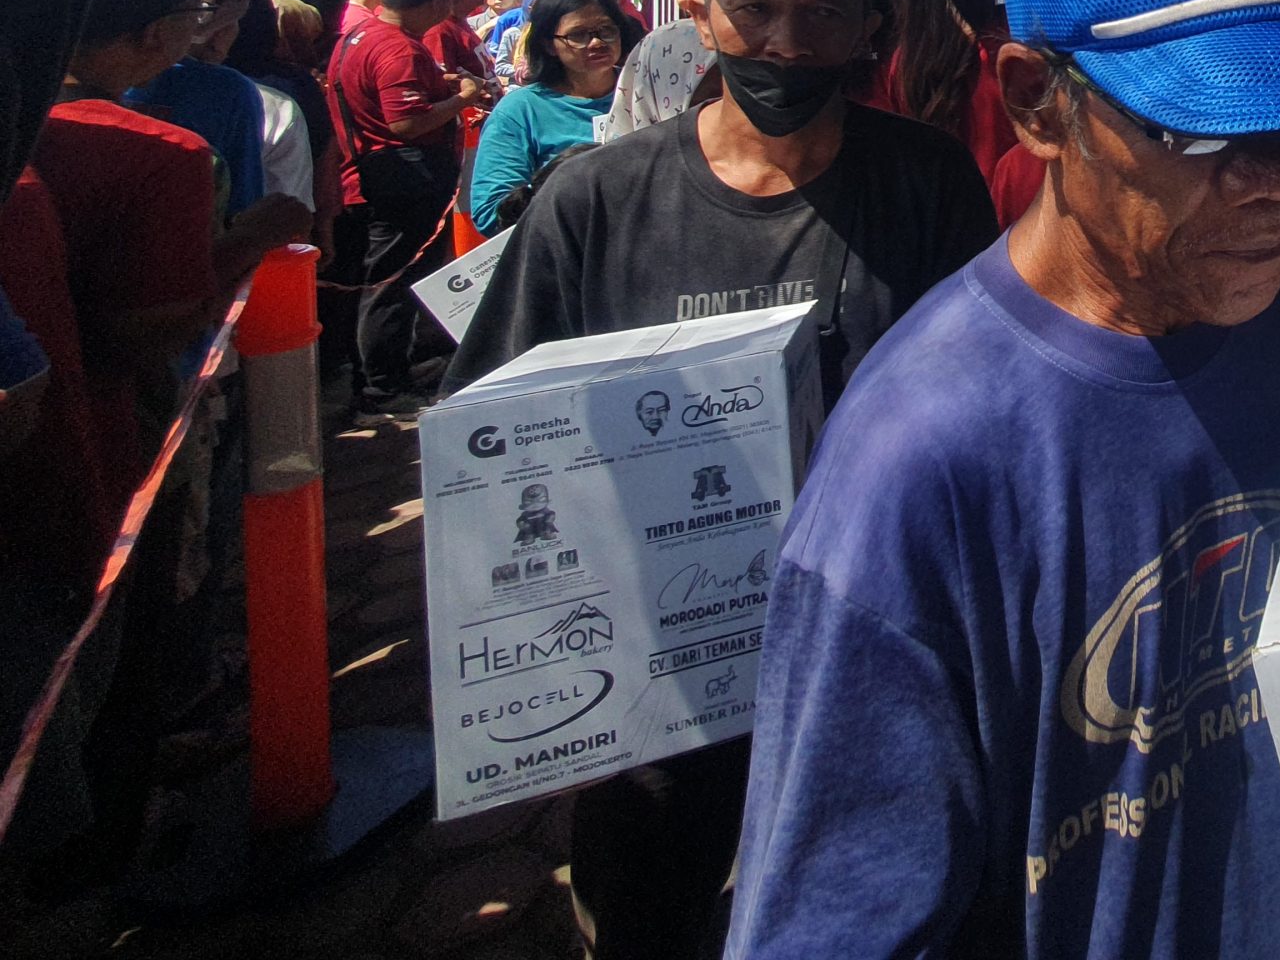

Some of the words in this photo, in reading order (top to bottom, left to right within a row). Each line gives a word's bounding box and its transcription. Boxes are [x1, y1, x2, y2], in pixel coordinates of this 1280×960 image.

[676, 289, 751, 322] DON'T
[514, 417, 570, 434] Ganesha
[682, 385, 764, 428] Anda
[514, 426, 581, 447] Operation
[645, 521, 685, 540] TIRTO
[688, 511, 733, 531] AGUNG
[736, 499, 782, 519] MOTOR
[659, 602, 726, 628] MORODADI
[729, 591, 769, 612] PUTRA
[650, 660, 667, 674] CV.
[672, 650, 701, 668] DARI
[705, 637, 746, 659] TEMAN
[461, 685, 584, 728] BEJOCELL
[665, 708, 728, 735] SUMBER
[466, 762, 508, 784] UD.
[515, 729, 617, 771] MANDIRI
[573, 751, 633, 774] MOJOKERTO
